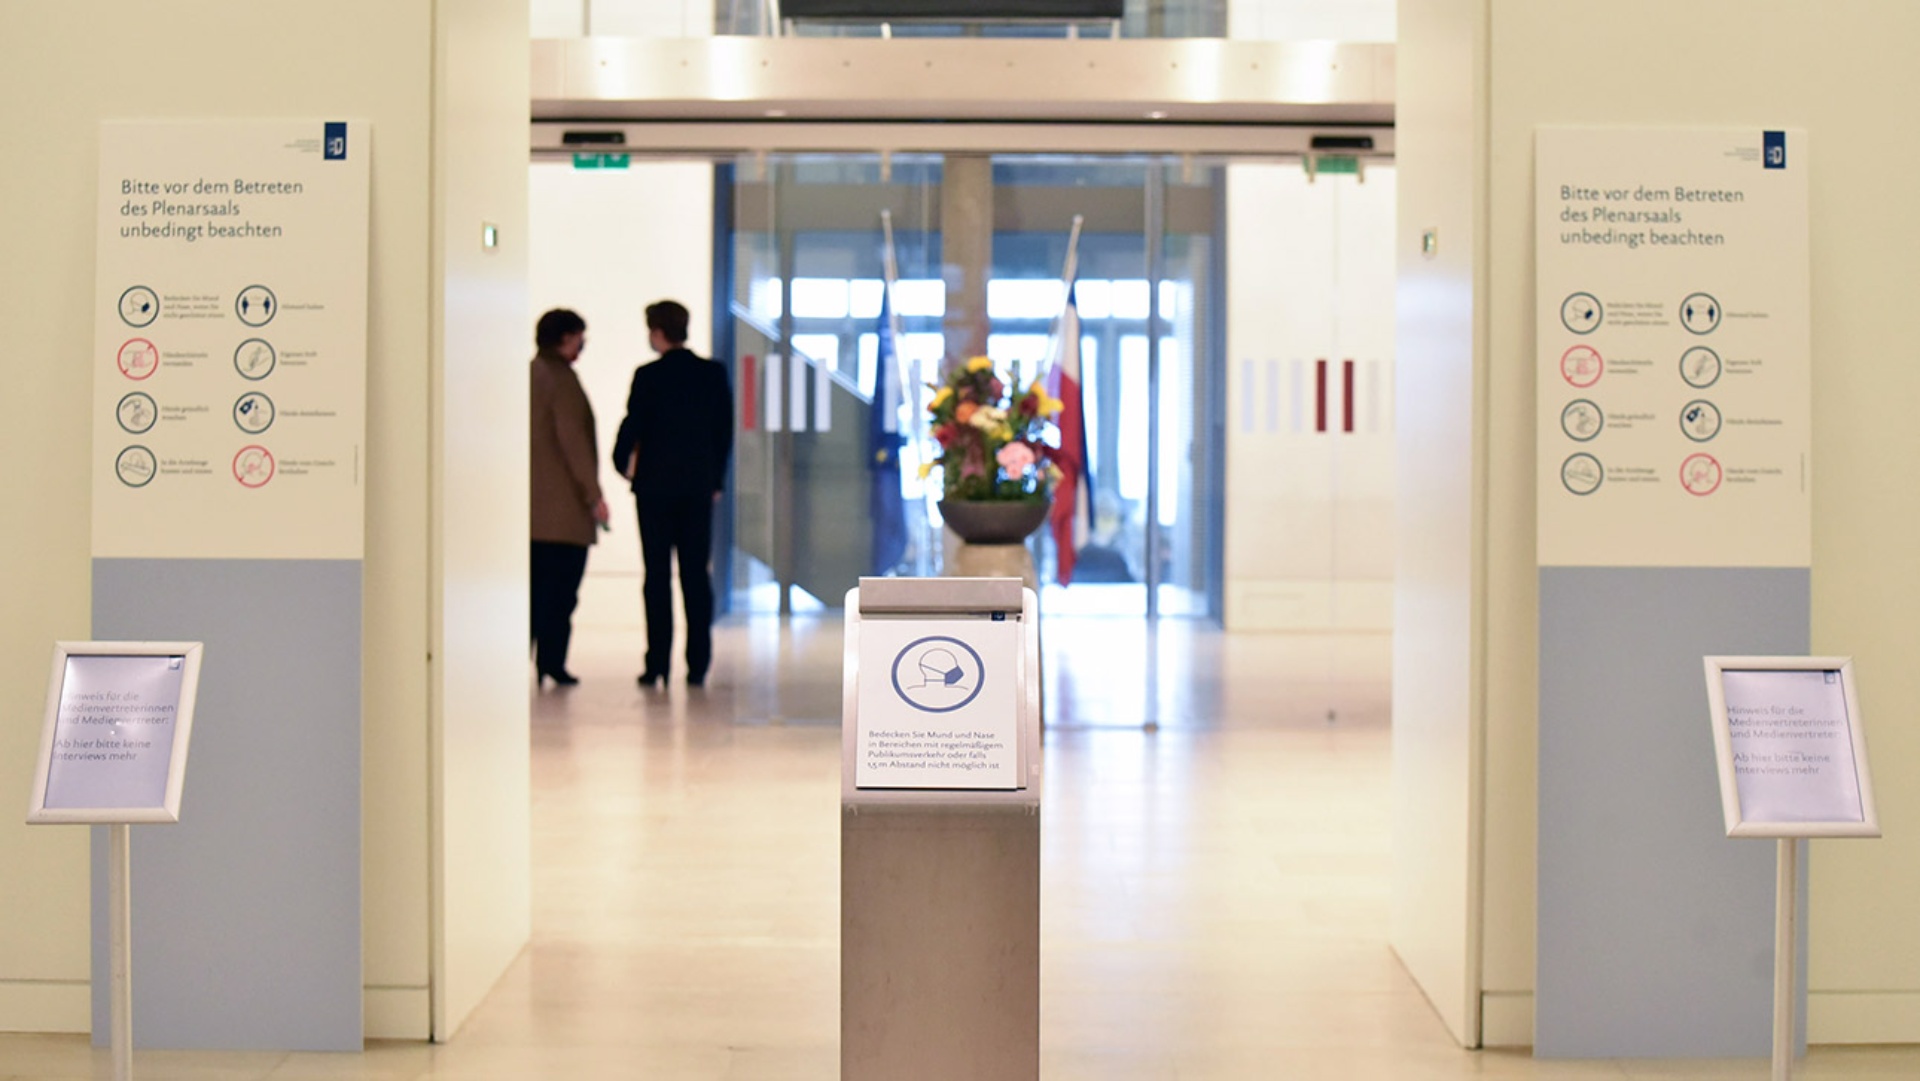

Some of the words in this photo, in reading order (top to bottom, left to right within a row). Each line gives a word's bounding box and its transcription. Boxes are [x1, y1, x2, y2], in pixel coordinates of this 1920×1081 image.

[121, 179, 160, 195] Bitte
[164, 181, 189, 195] vor
[193, 178, 229, 195] dem
[234, 179, 304, 195] Betreten
[1560, 185, 1599, 201] Bitte
[1603, 188, 1629, 201] vor
[1633, 186, 1670, 202] dem
[1674, 187, 1744, 202] Betreten
[120, 200, 148, 216] des
[152, 200, 240, 216] Plenarsaals
[1560, 206, 1588, 222] des
[1592, 207, 1682, 223] Plenarsaals
[120, 221, 203, 242] unbedingt
[208, 221, 283, 237] beachten
[1560, 228, 1644, 249] unbedingt
[1649, 228, 1725, 245] beachten
[868, 730, 910, 738] Bedecken
[911, 731, 925, 739] Sie
[927, 731, 953, 739] Mund
[954, 731, 972, 739] und
[73, 739, 93, 748] hier
[96, 739, 120, 748] bitte
[123, 739, 151, 748] keine
[109, 751, 138, 761] mehr
[947, 750, 967, 758] oder
[1800, 752, 1830, 763] keine
